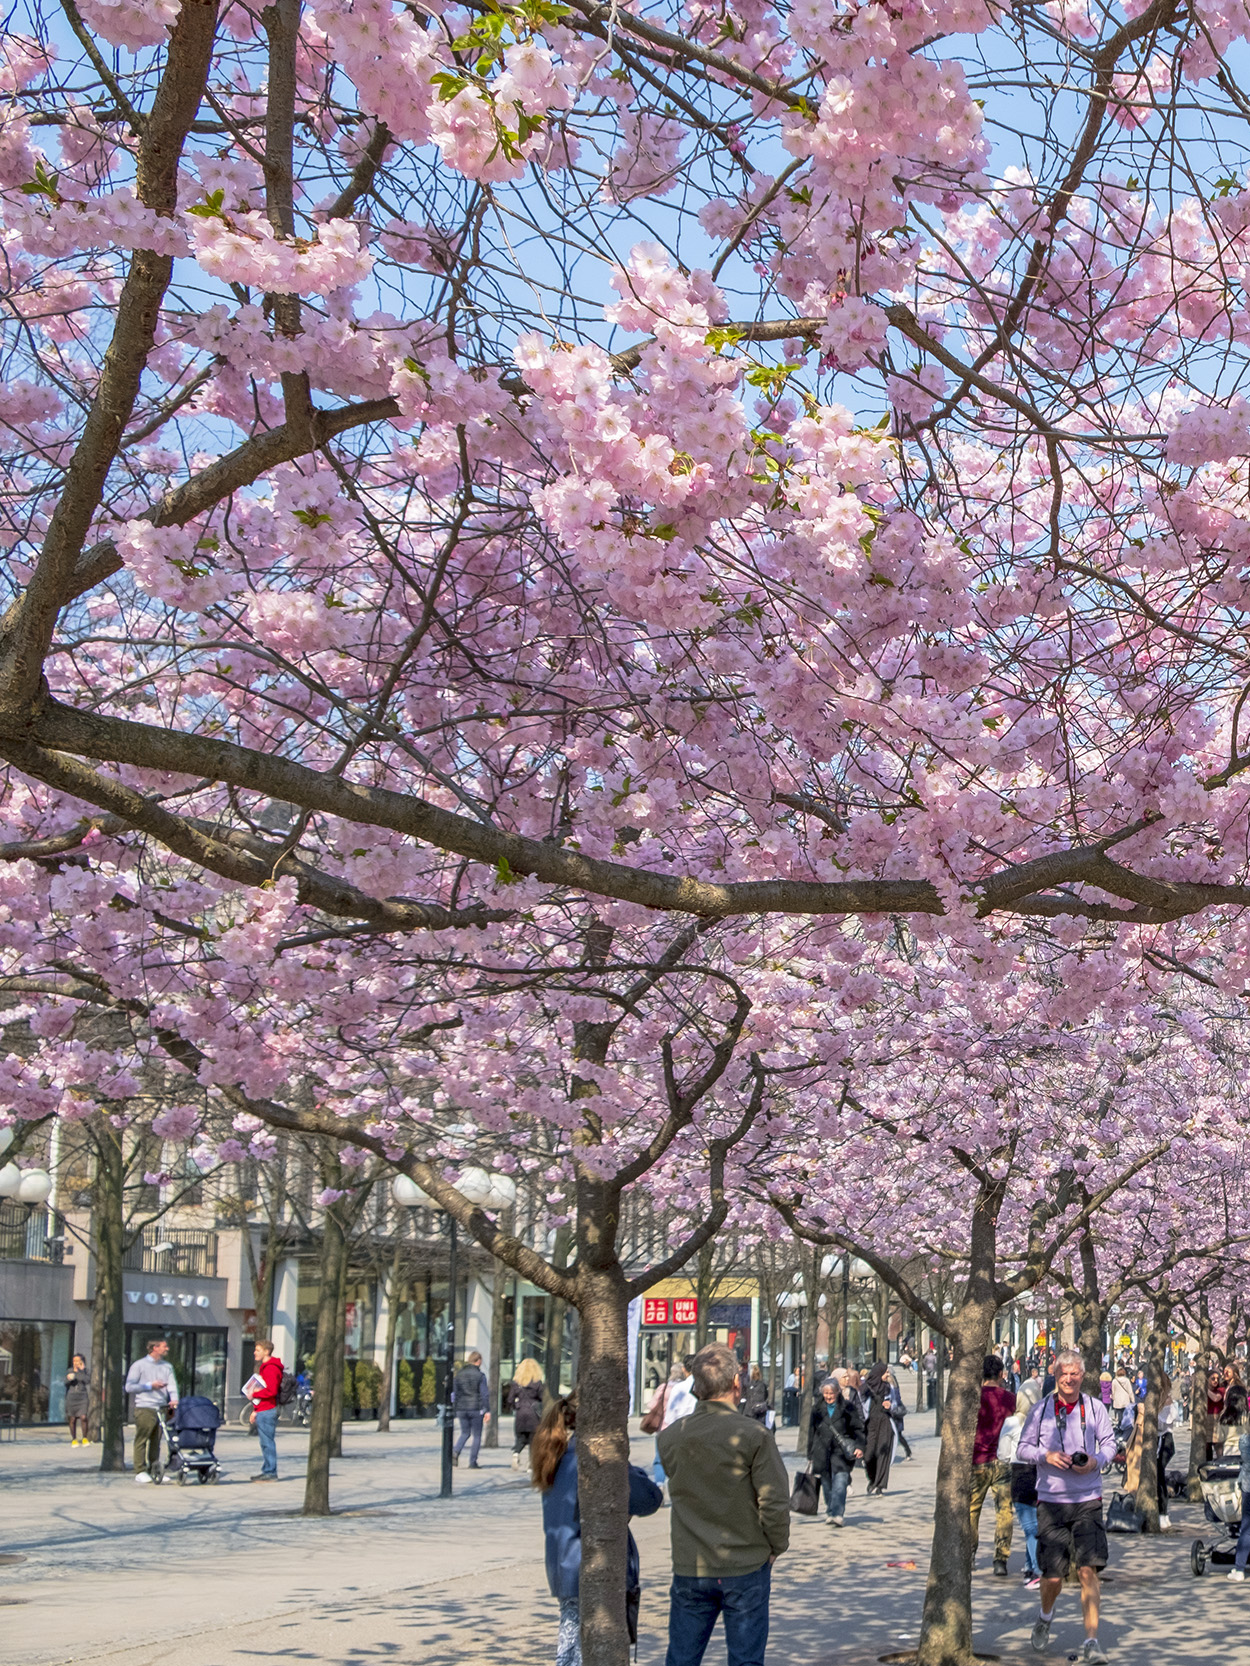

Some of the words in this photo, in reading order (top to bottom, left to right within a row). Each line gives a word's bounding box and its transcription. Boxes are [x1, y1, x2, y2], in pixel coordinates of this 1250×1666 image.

[125, 1291, 209, 1308] VOLVO
[675, 1301, 694, 1310] UNI
[675, 1312, 696, 1322] QLO
